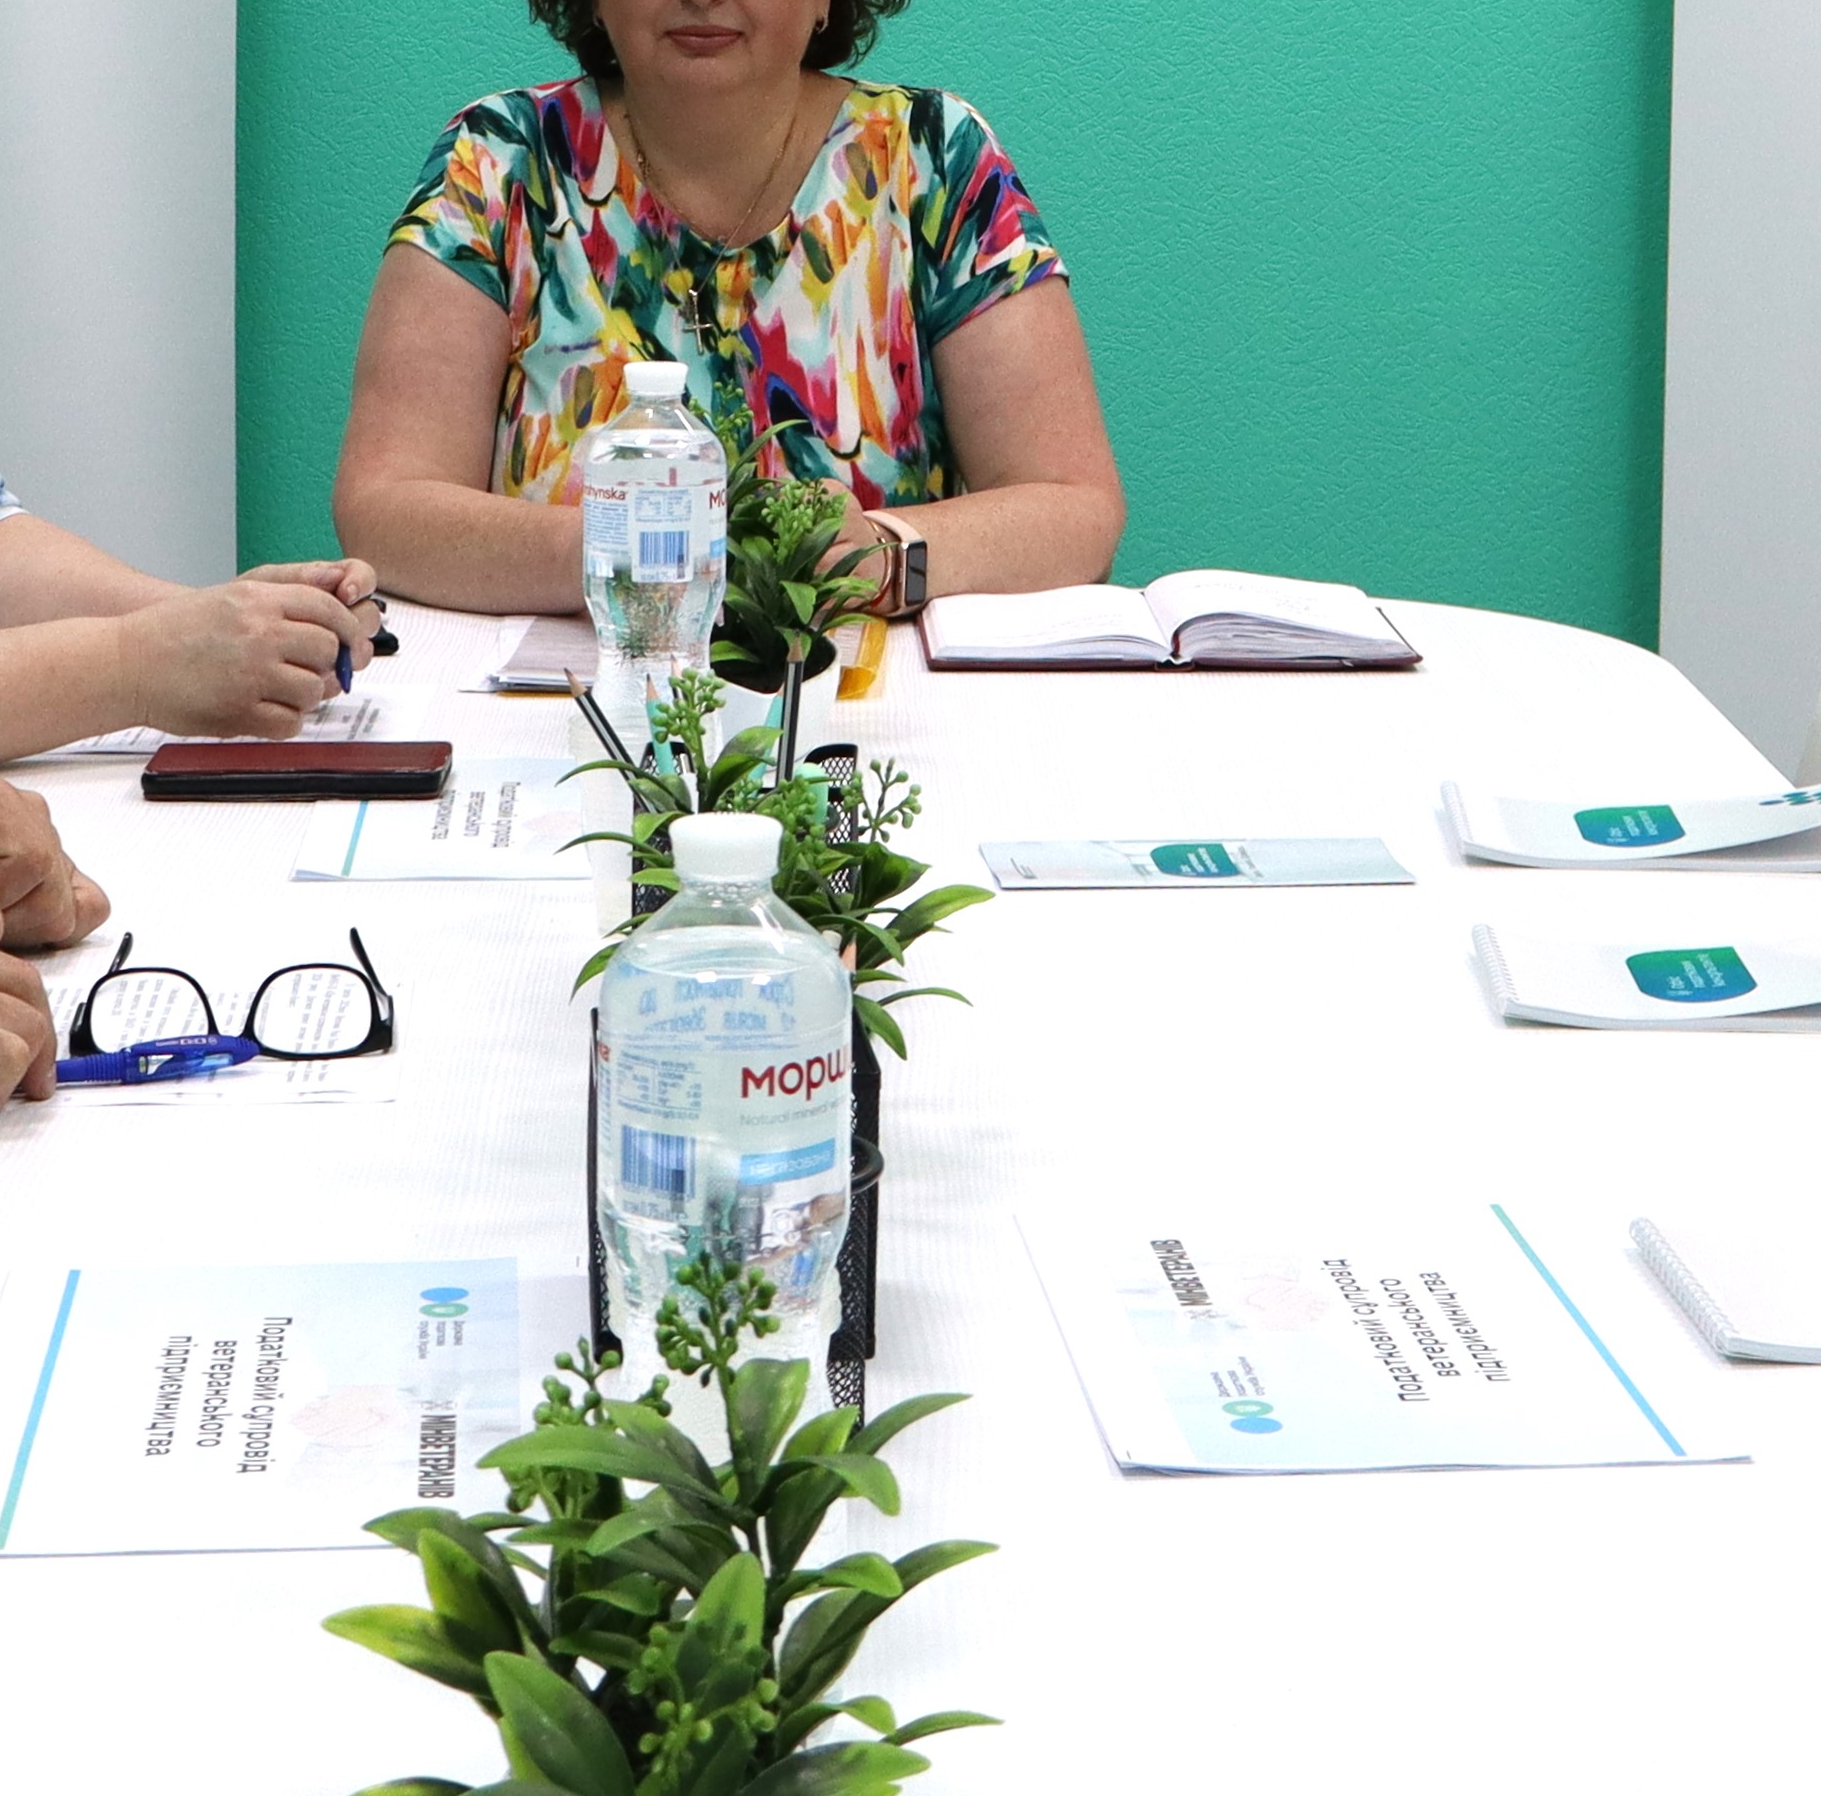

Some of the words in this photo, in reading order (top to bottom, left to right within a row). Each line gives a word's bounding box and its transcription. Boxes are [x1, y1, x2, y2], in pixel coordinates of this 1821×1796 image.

[1150, 1239, 1213, 1307] МІНВЕТЕРАНІВ
[1320, 1258, 1380, 1317] супровід
[252, 1316, 293, 1403] Податковий
[1351, 1318, 1431, 1403] Податковий
[1379, 1277, 1462, 1378] ветеранського
[1418, 1271, 1512, 1383] підприємництва
[144, 1335, 199, 1458] підприємництва
[195, 1339, 238, 1448] ветеранського
[236, 1404, 276, 1474] супровід
[417, 1414, 457, 1499] МІНВЕТЕРАНІВ
